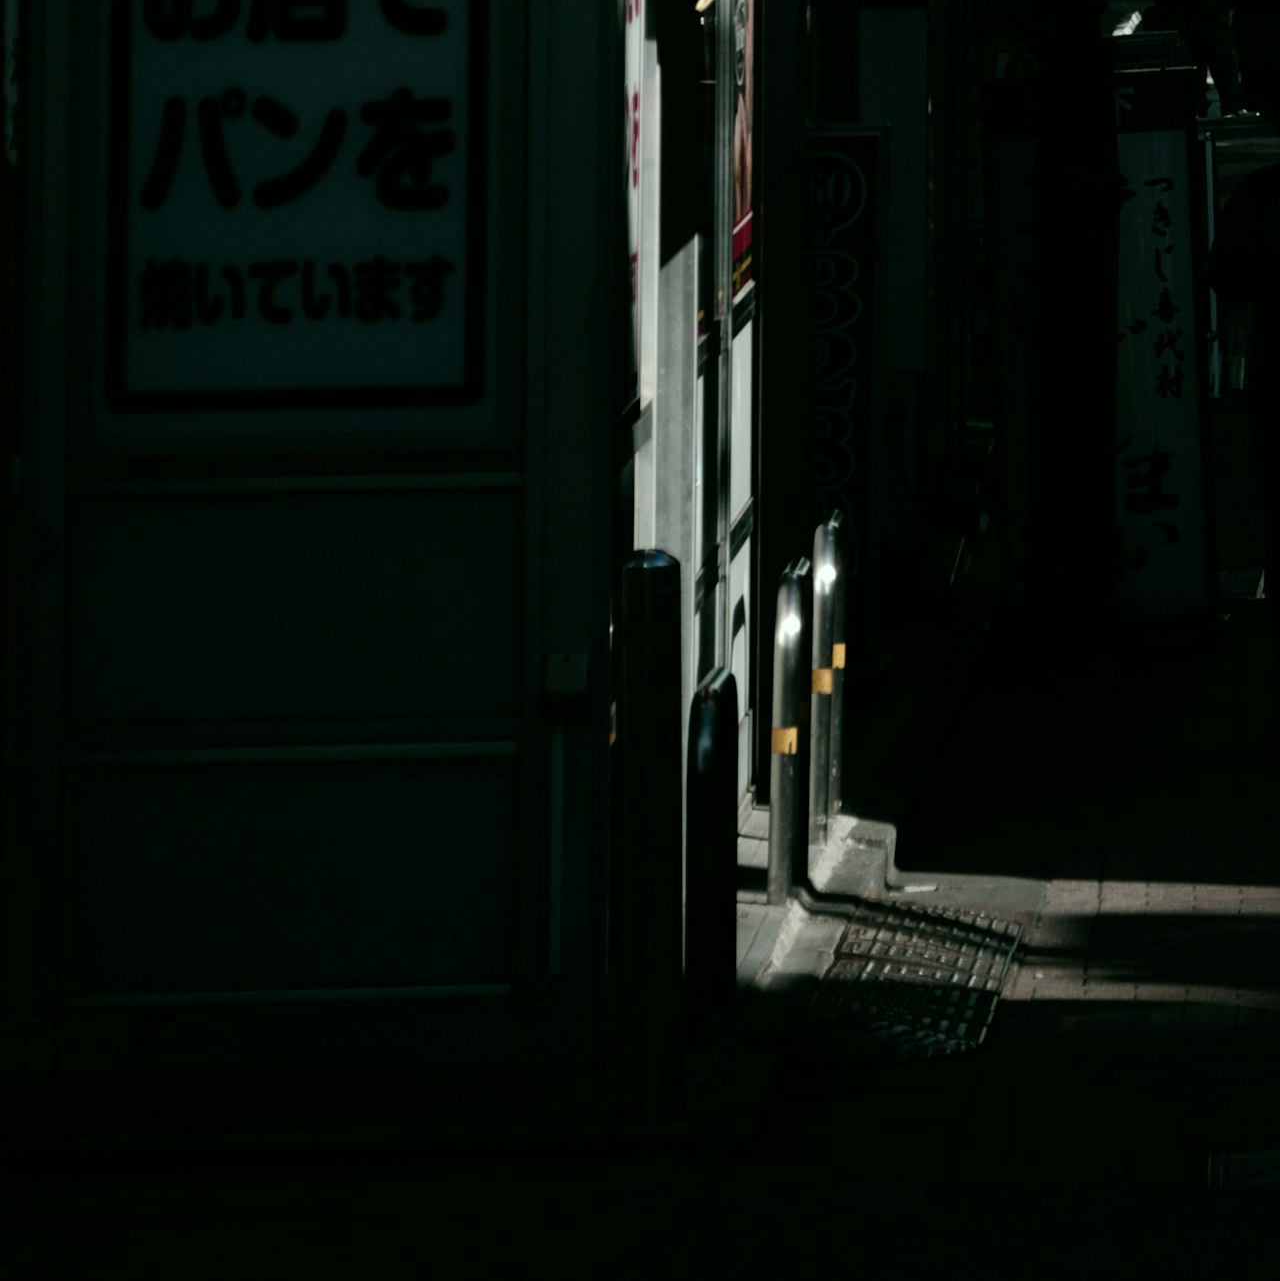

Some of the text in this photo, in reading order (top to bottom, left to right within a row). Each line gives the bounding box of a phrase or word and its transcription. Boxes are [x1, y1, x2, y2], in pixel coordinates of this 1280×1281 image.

[140, 87, 456, 211] パンを
[138, 255, 455, 331] 焼いています
